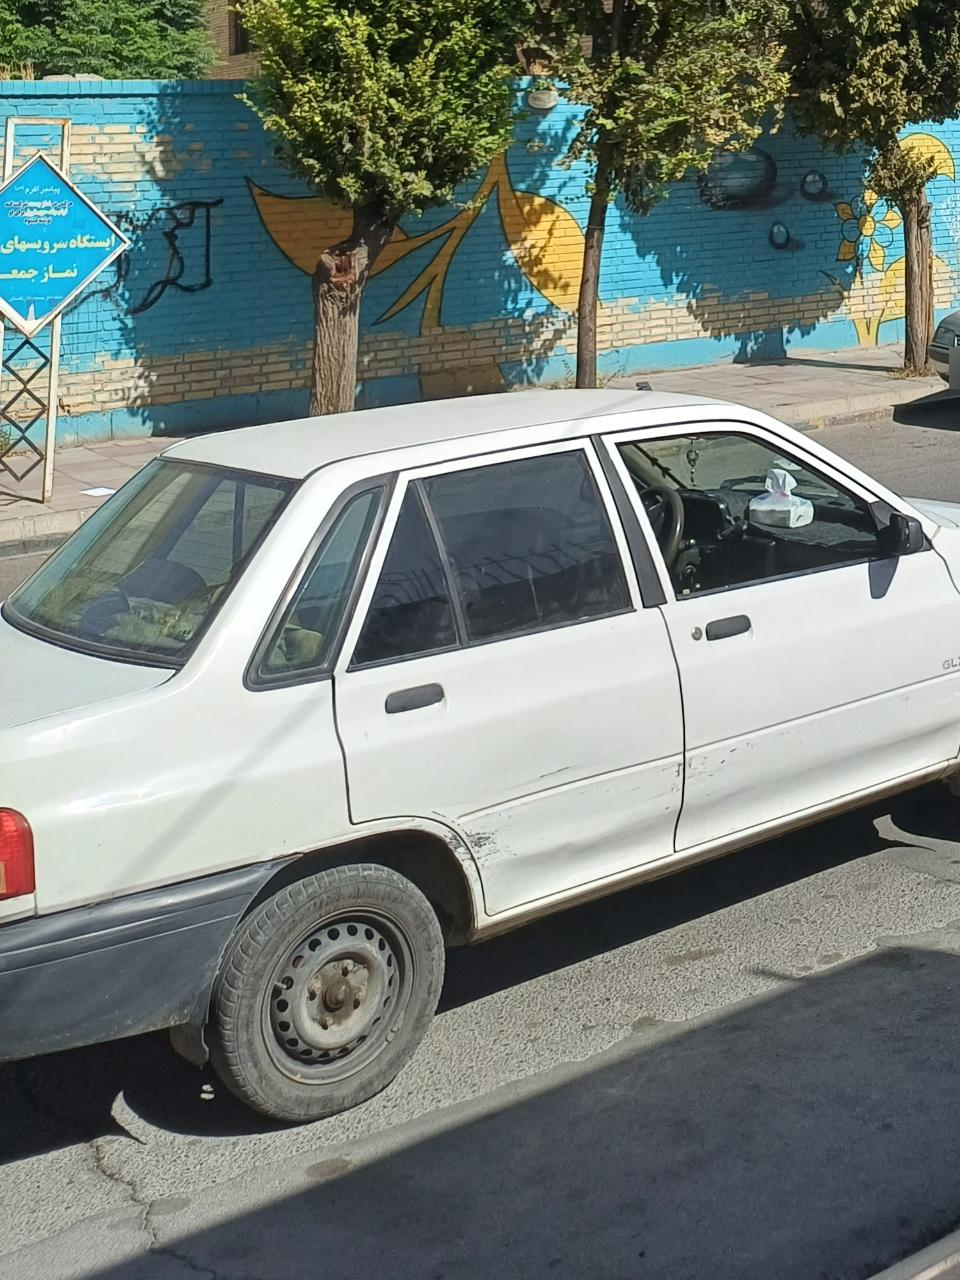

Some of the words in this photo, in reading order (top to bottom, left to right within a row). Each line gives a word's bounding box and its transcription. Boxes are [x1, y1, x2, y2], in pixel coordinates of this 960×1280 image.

[69, 233, 116, 251] ایستگاه
[0, 268, 39, 282] جمع
[40, 263, 78, 283] نماز
